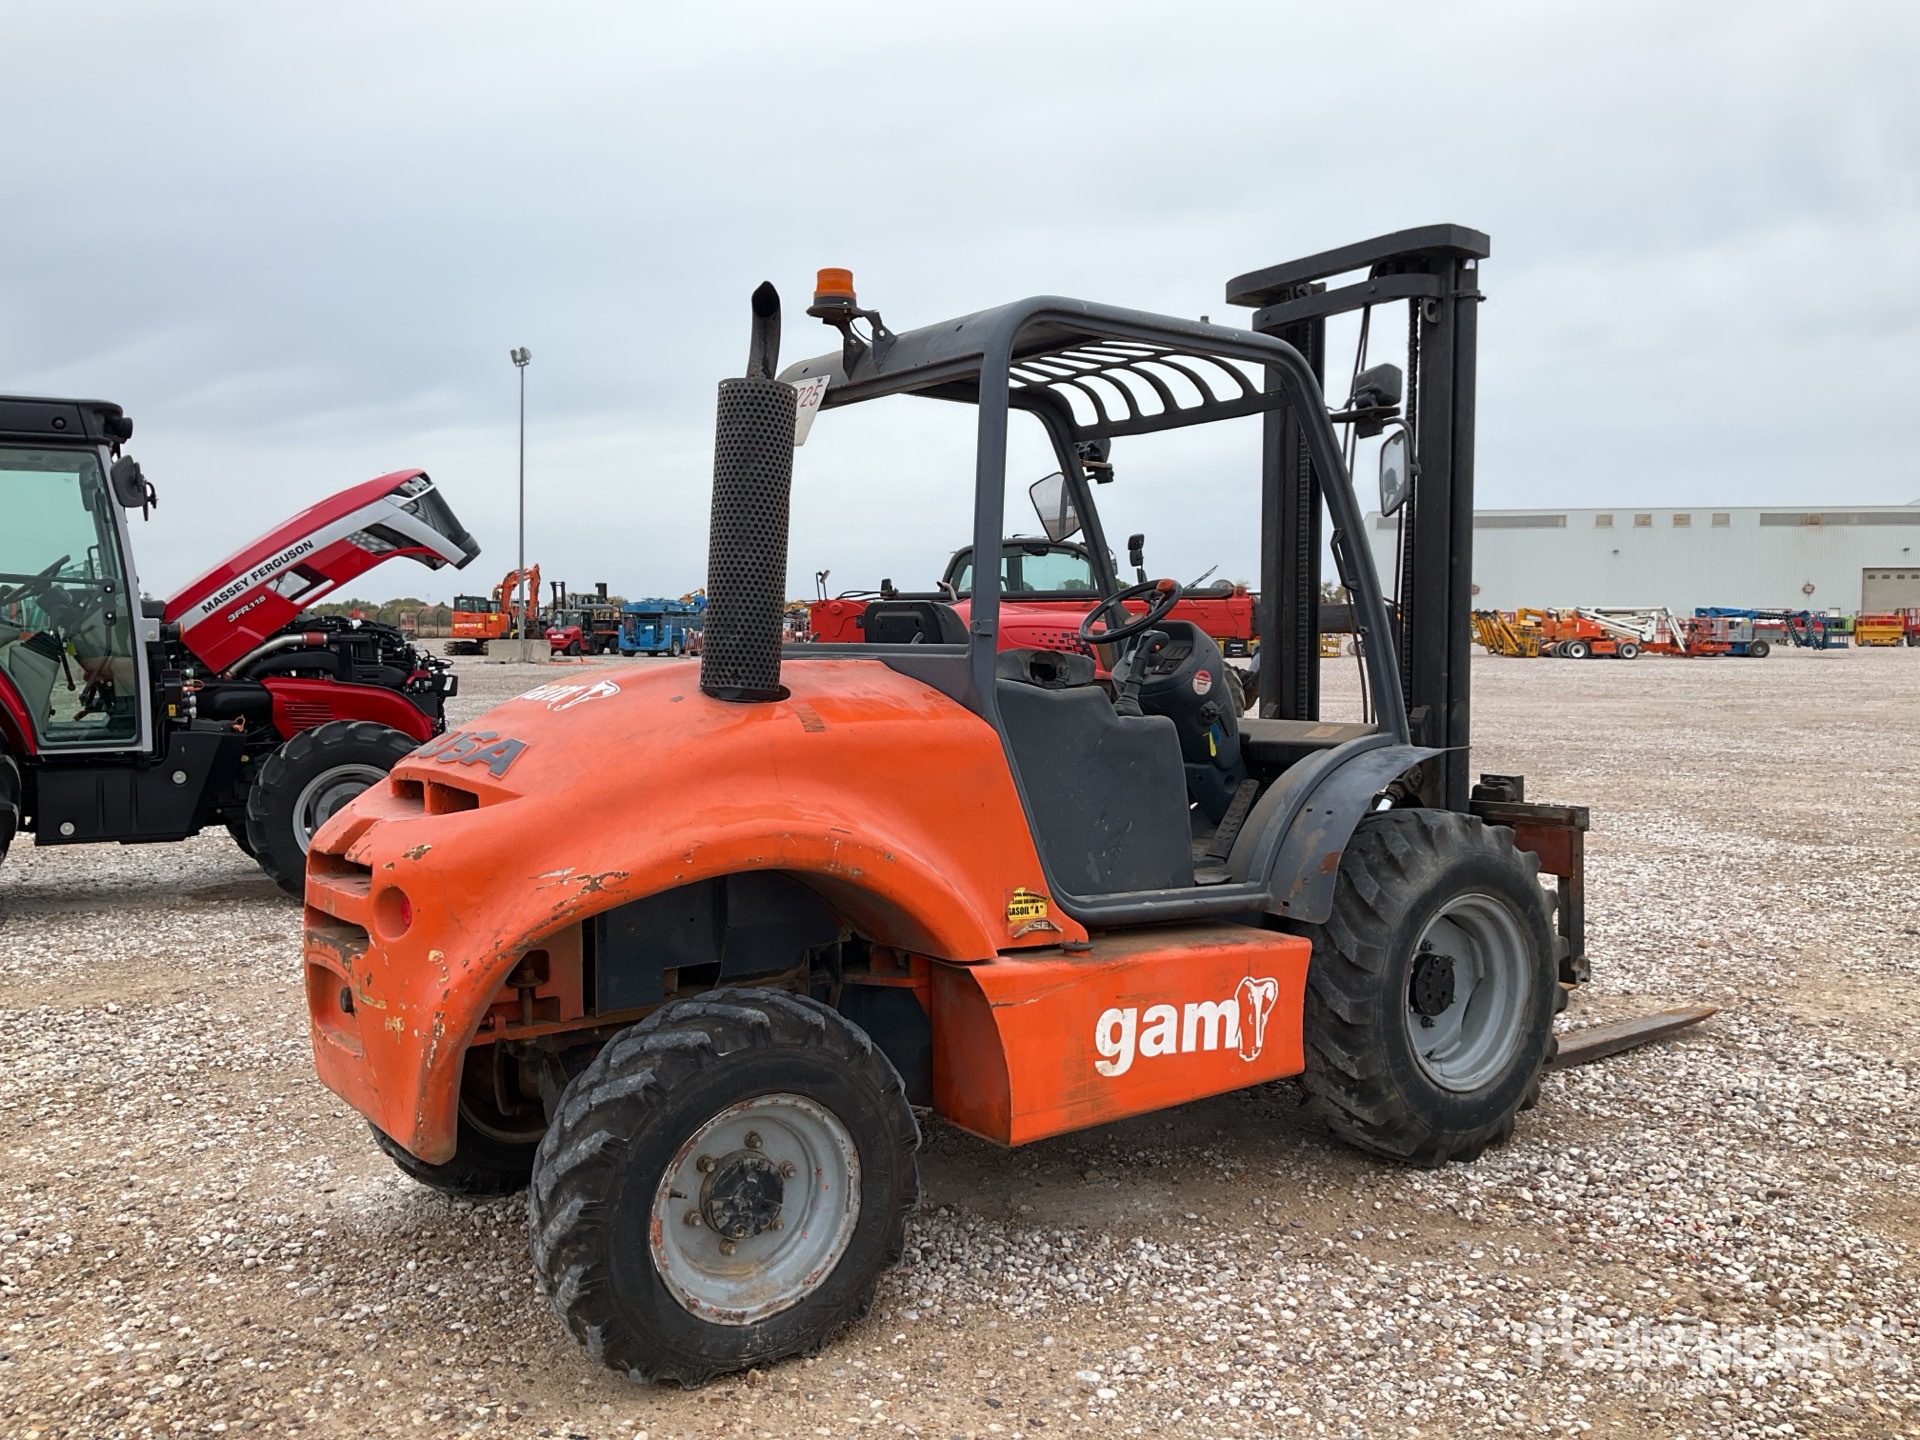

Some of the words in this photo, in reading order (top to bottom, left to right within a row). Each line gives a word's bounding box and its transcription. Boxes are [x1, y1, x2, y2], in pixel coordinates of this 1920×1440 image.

[201, 576, 250, 613] MASSEY
[250, 540, 314, 581] FERGUSON
[408, 730, 529, 779] USA
[1094, 999, 1240, 1077] gam
